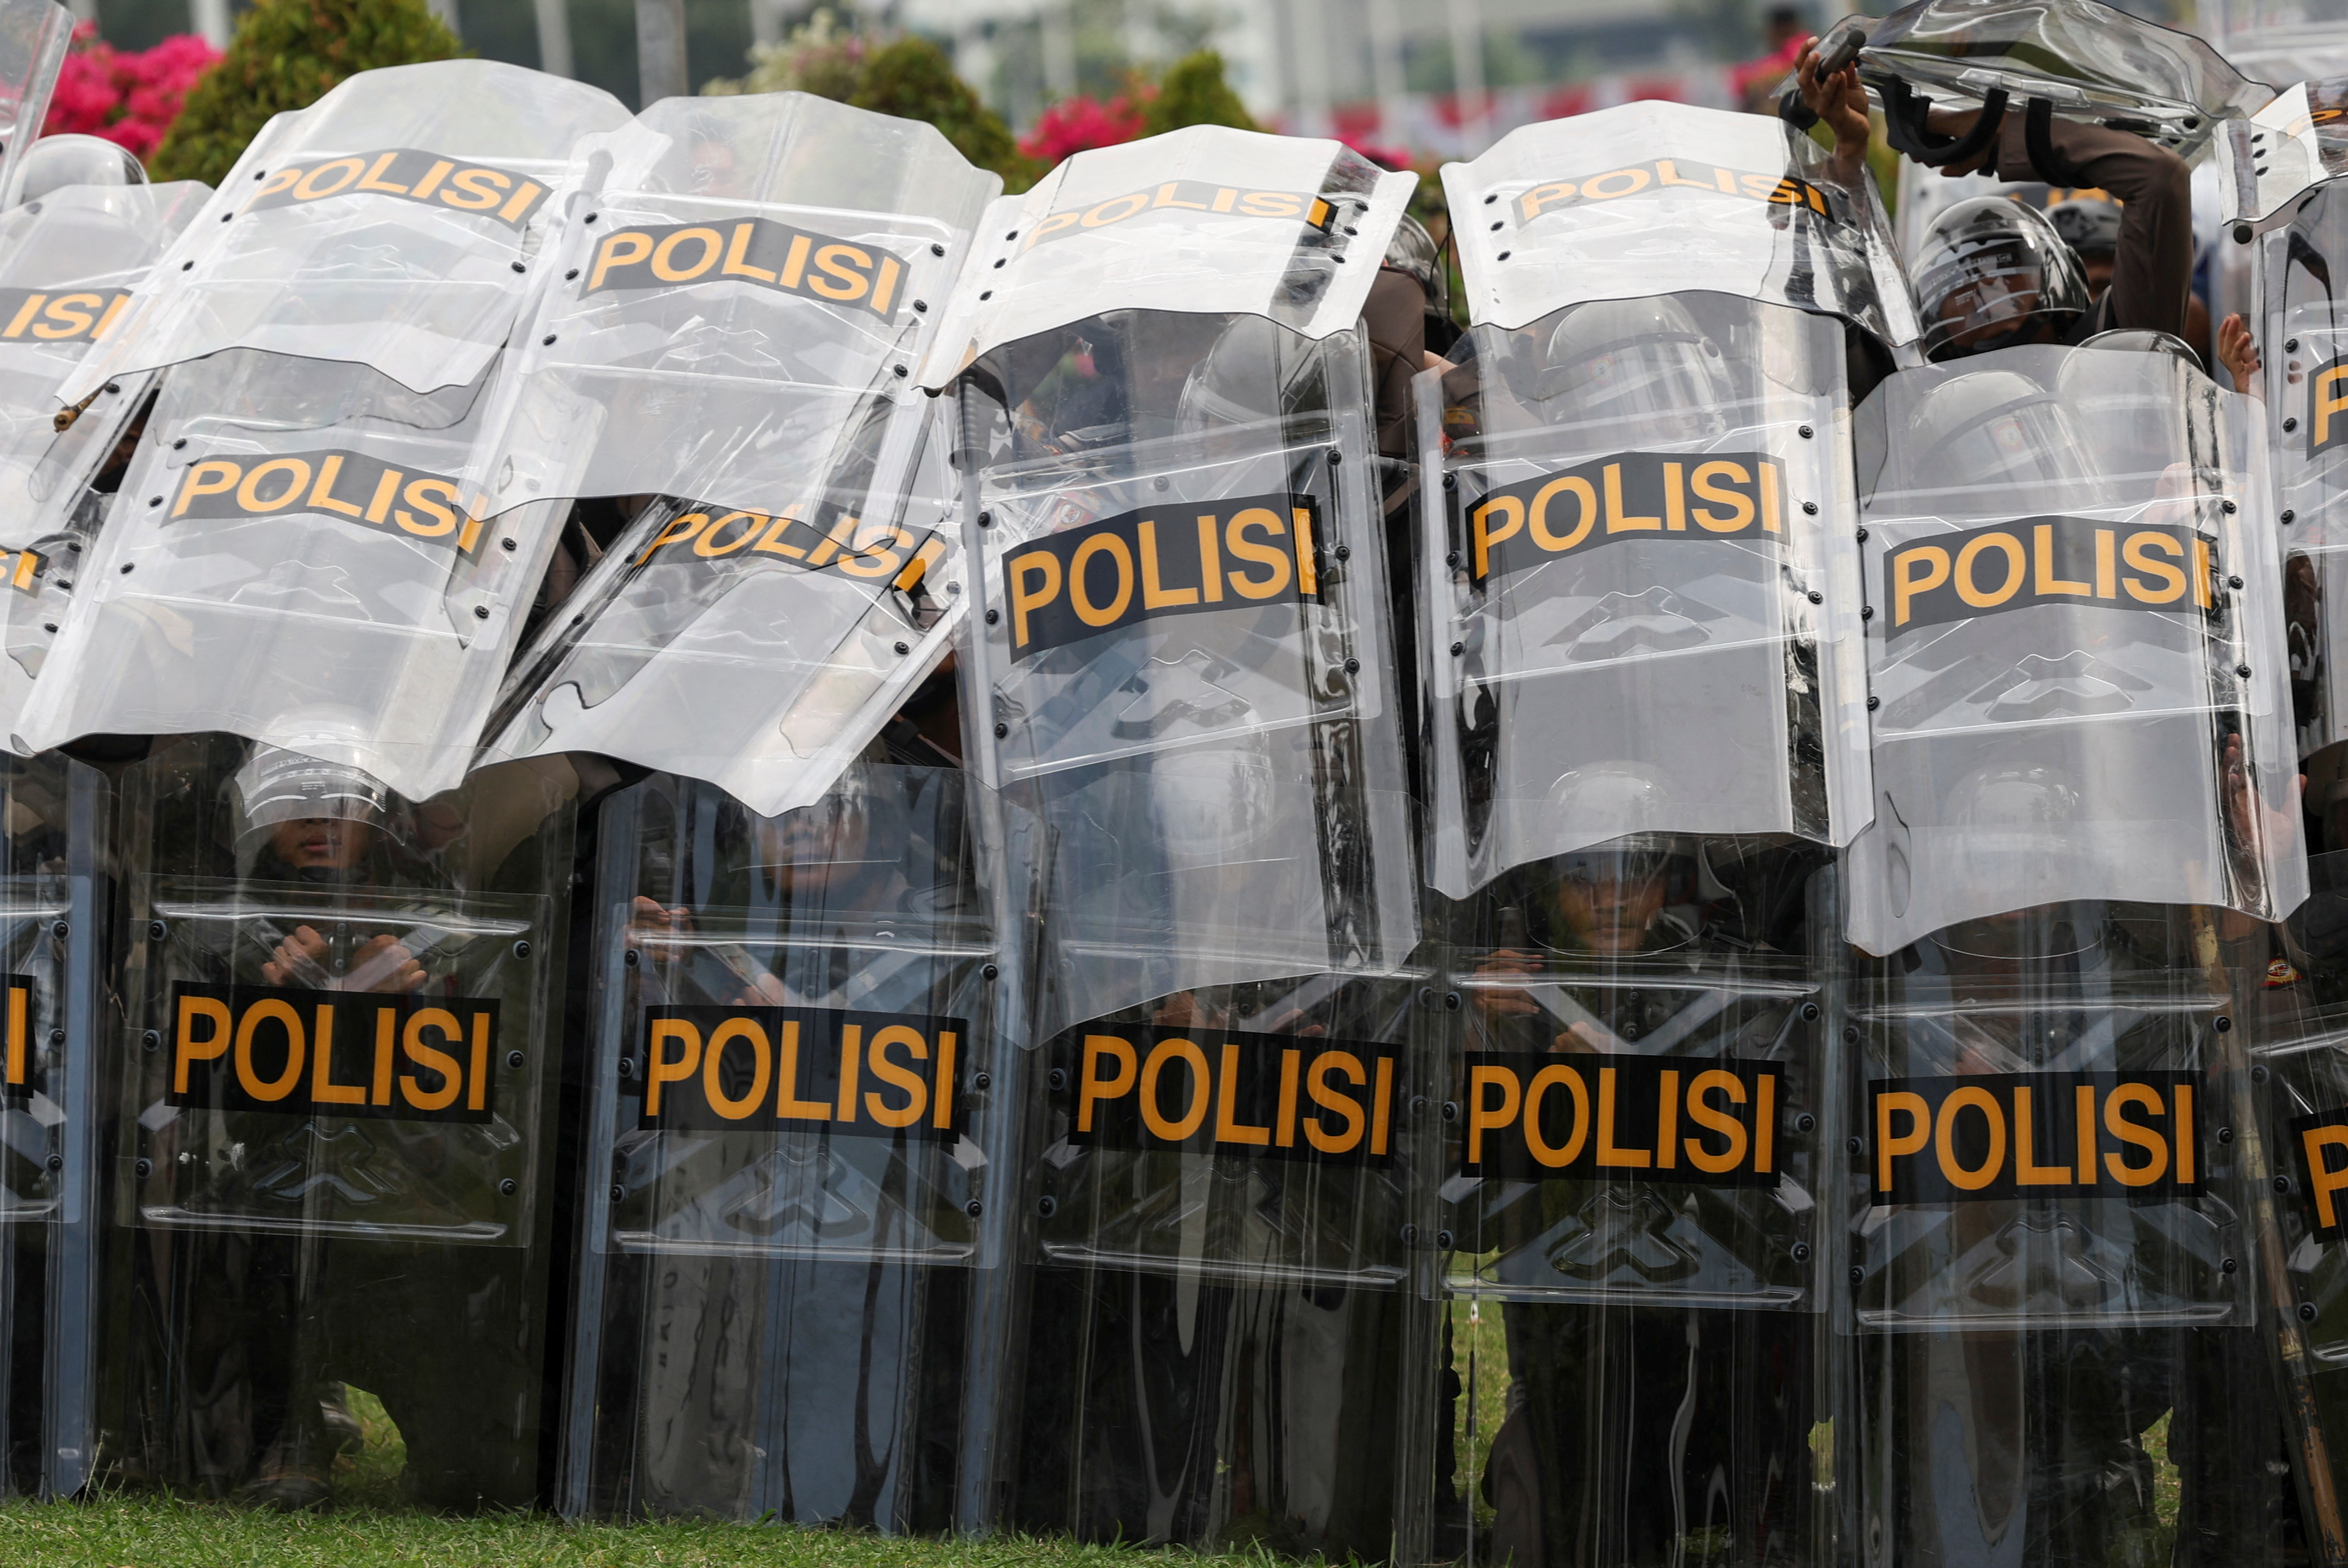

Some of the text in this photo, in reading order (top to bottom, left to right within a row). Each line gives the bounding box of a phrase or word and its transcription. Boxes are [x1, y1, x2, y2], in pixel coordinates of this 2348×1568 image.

[2286, 110, 2348, 140] P
[238, 153, 540, 222] POLISI
[1021, 183, 1330, 254] POLISI
[1523, 160, 1828, 221] POLISI
[587, 223, 901, 315] POLISI
[172, 455, 488, 554] POLISI
[632, 504, 946, 592] POLISI
[1473, 461, 1782, 580] POLISI
[1009, 507, 1317, 649] POLISI
[1893, 524, 2212, 627] POLISI
[174, 996, 490, 1110] POLISI
[645, 1017, 957, 1129] POLISI
[1077, 1035, 1393, 1155] POLISI
[1468, 1064, 1775, 1173] POLISI
[1876, 1083, 2194, 1192] POLISI
